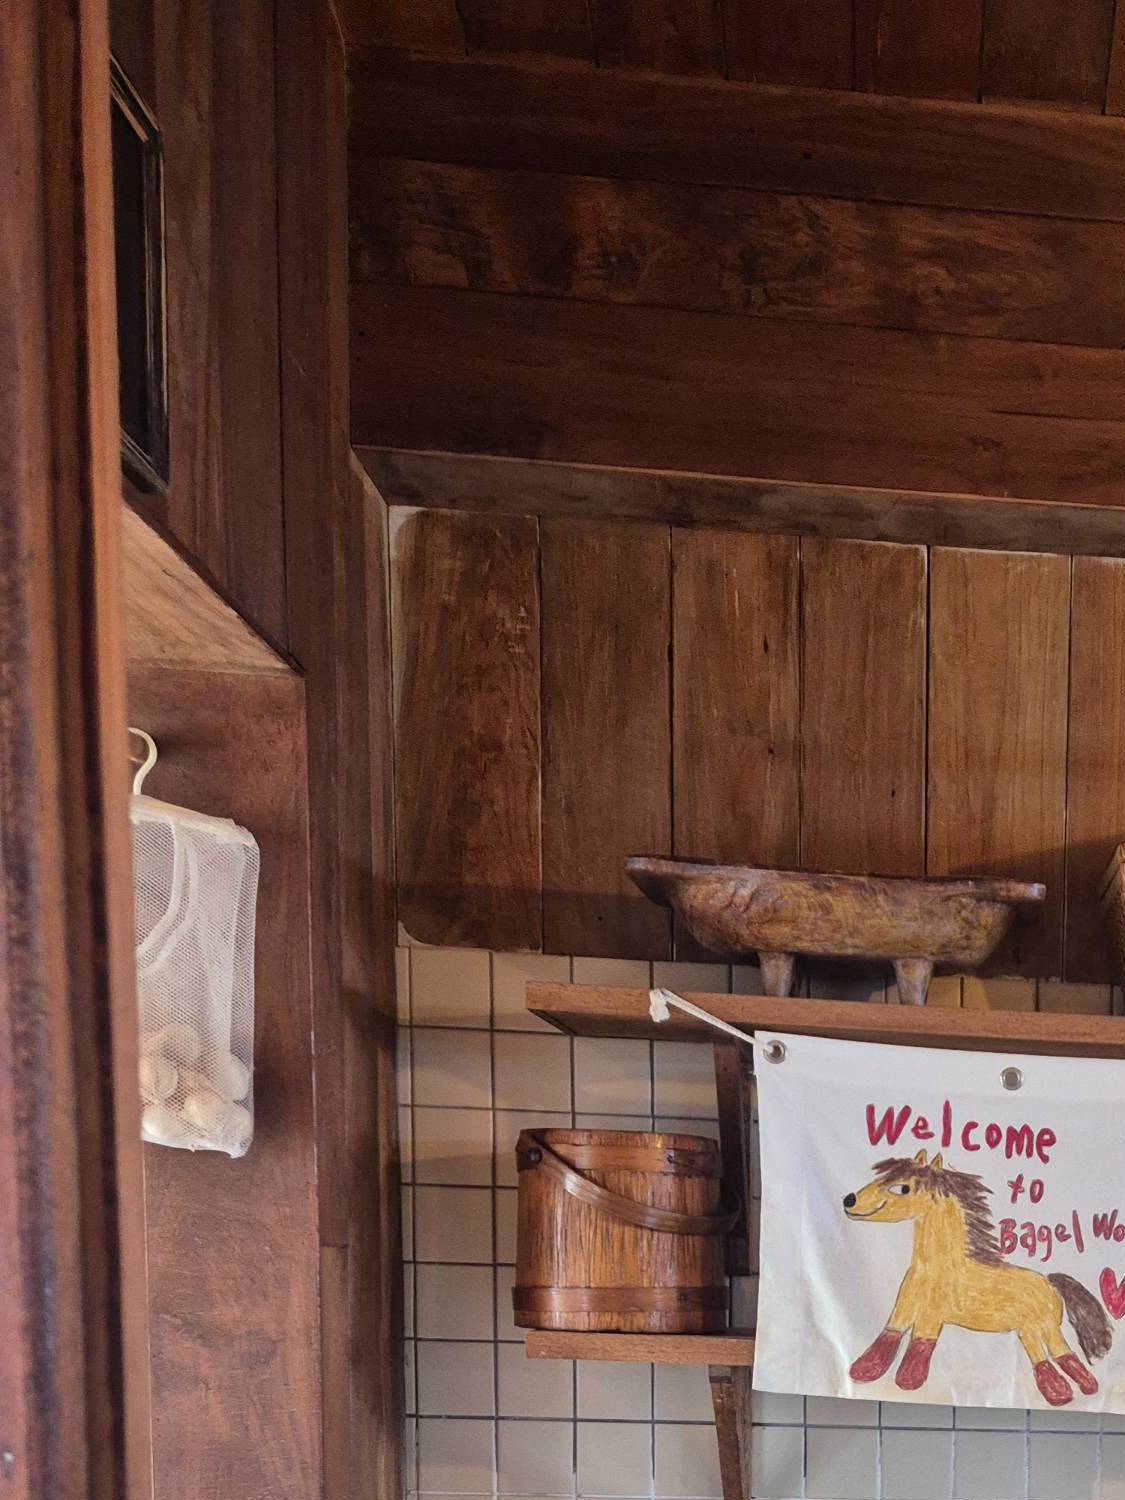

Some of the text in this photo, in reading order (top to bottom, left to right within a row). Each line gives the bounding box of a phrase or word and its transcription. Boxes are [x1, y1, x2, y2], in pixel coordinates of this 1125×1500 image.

[865, 1099, 1057, 1164] Welcome
[1007, 1173, 1045, 1204] to
[999, 1209, 1085, 1263] Bagel
